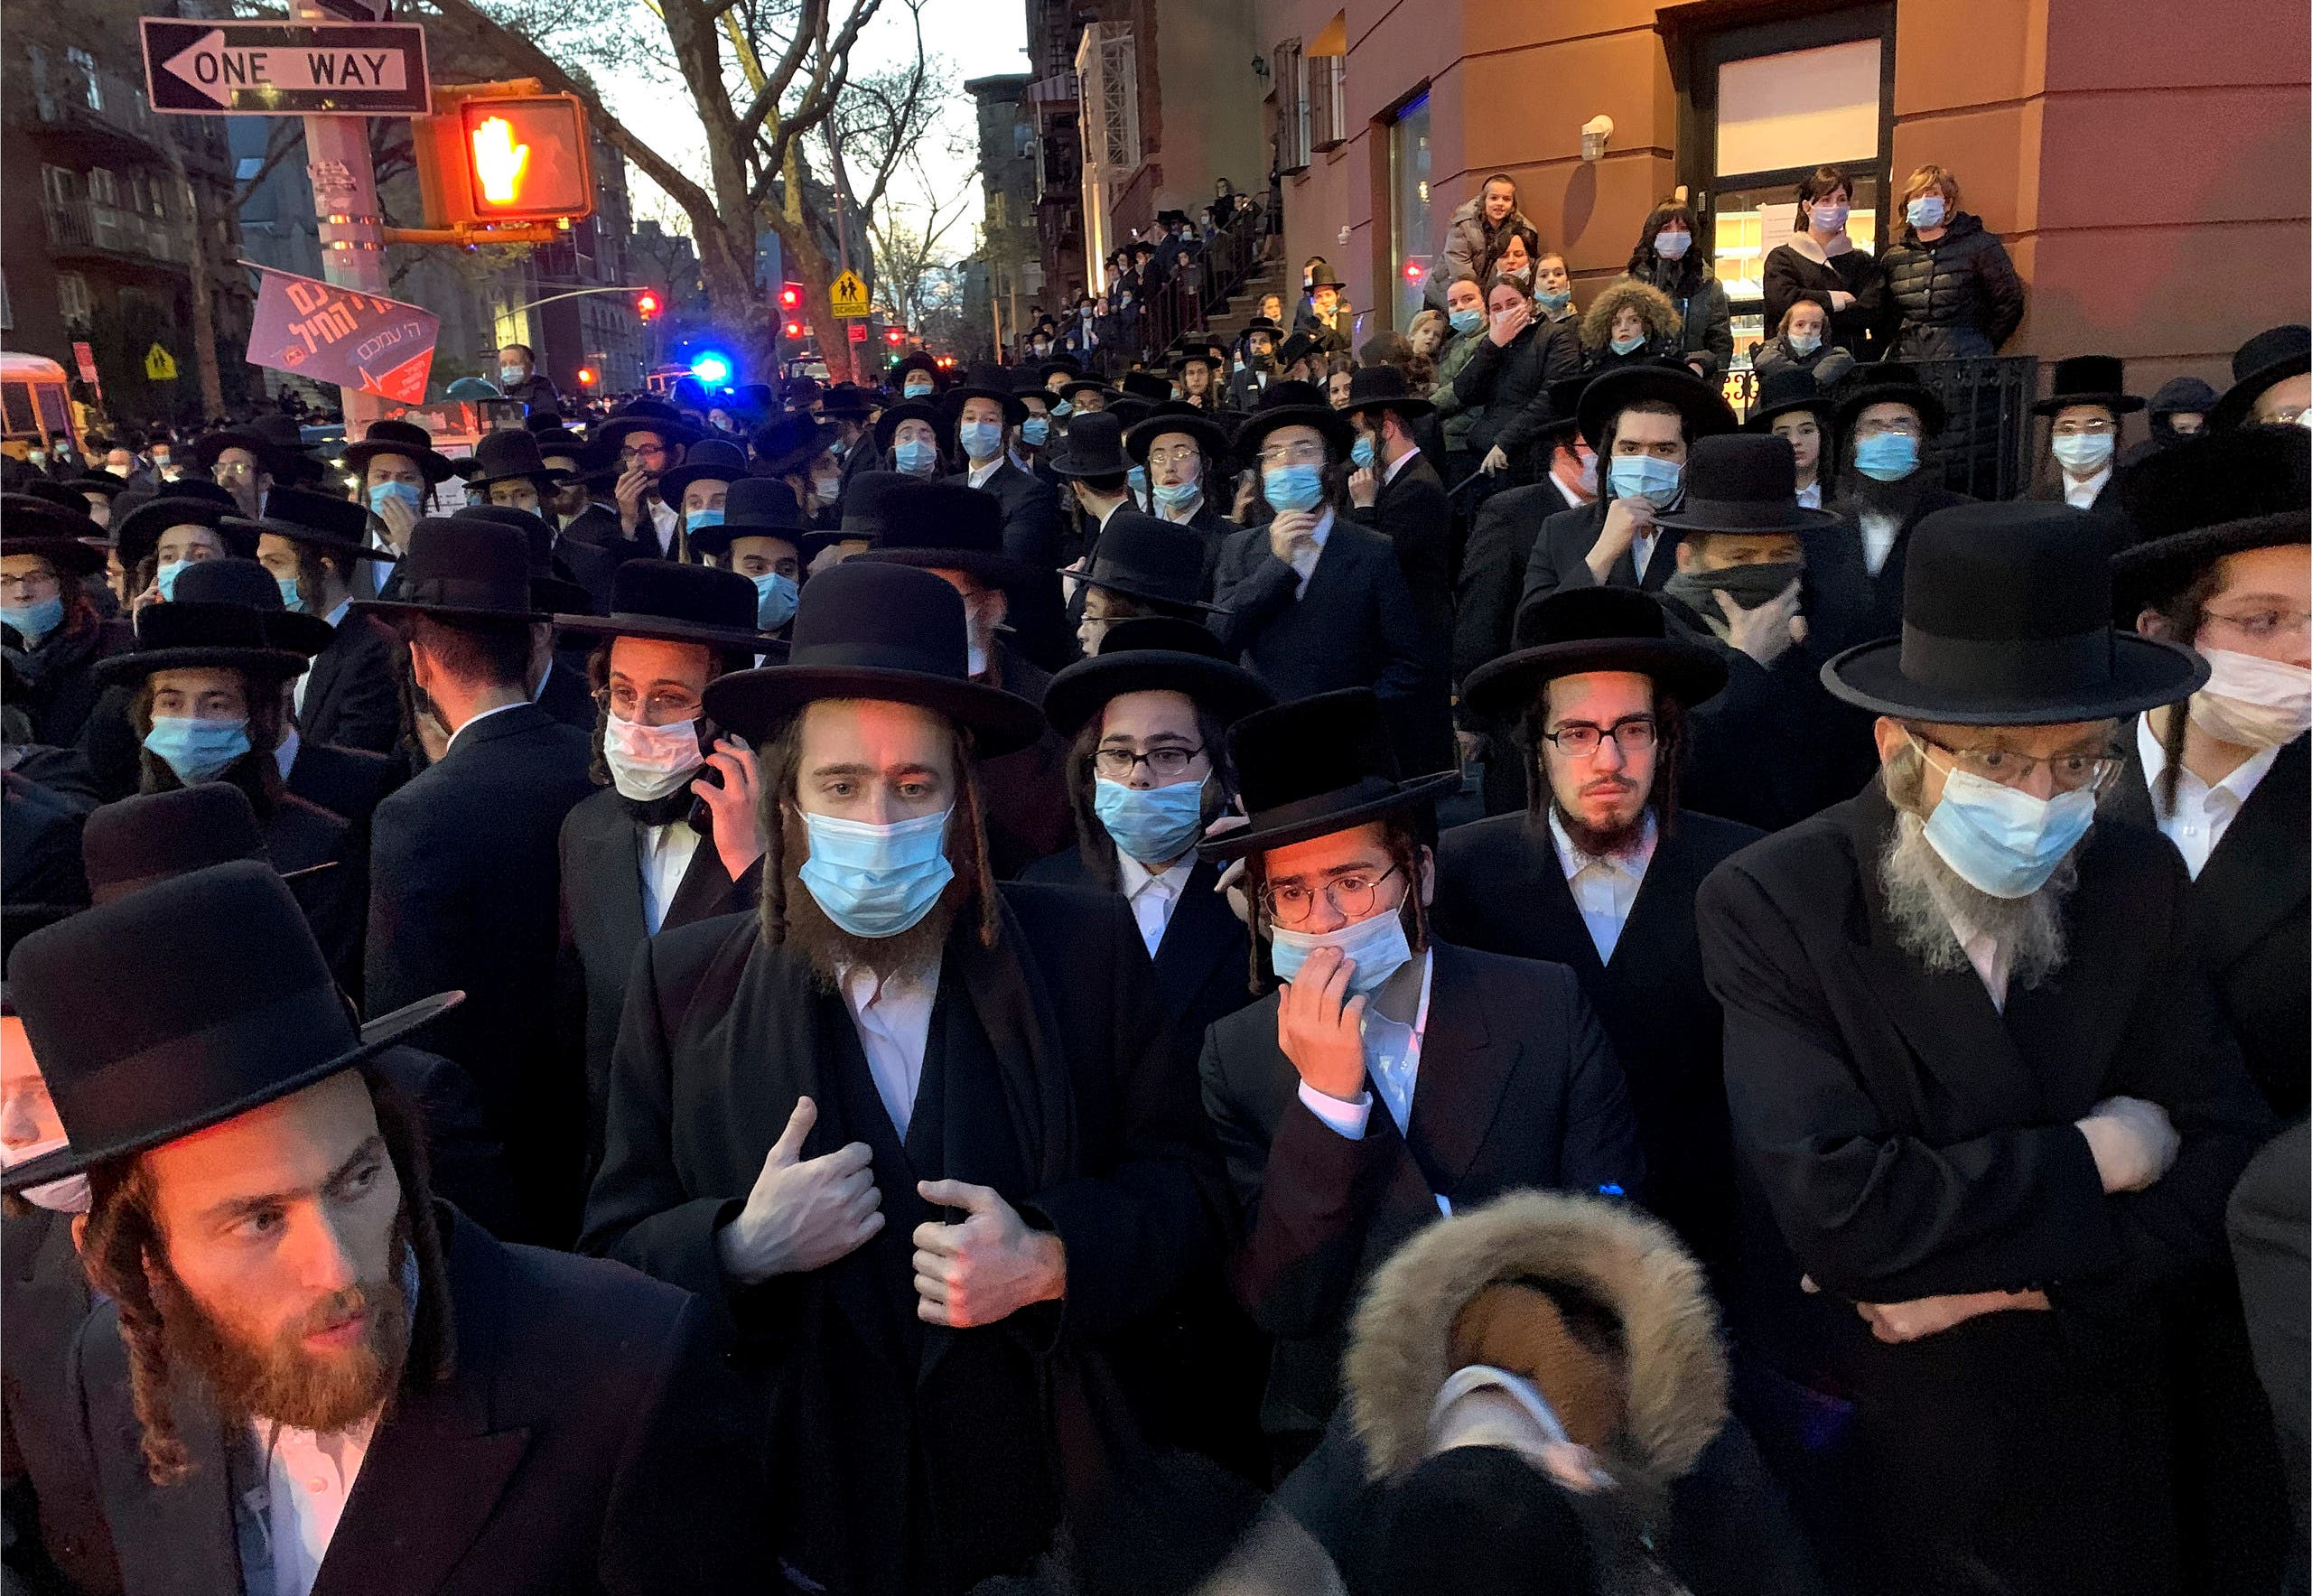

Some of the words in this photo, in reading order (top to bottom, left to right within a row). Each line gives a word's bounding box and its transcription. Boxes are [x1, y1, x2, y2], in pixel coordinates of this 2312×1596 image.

[194, 51, 271, 84] ONE
[308, 52, 387, 85] WAY
[834, 305, 866, 313] SCHOOL
[288, 301, 359, 355] החיל
[357, 327, 402, 360] עמכם
